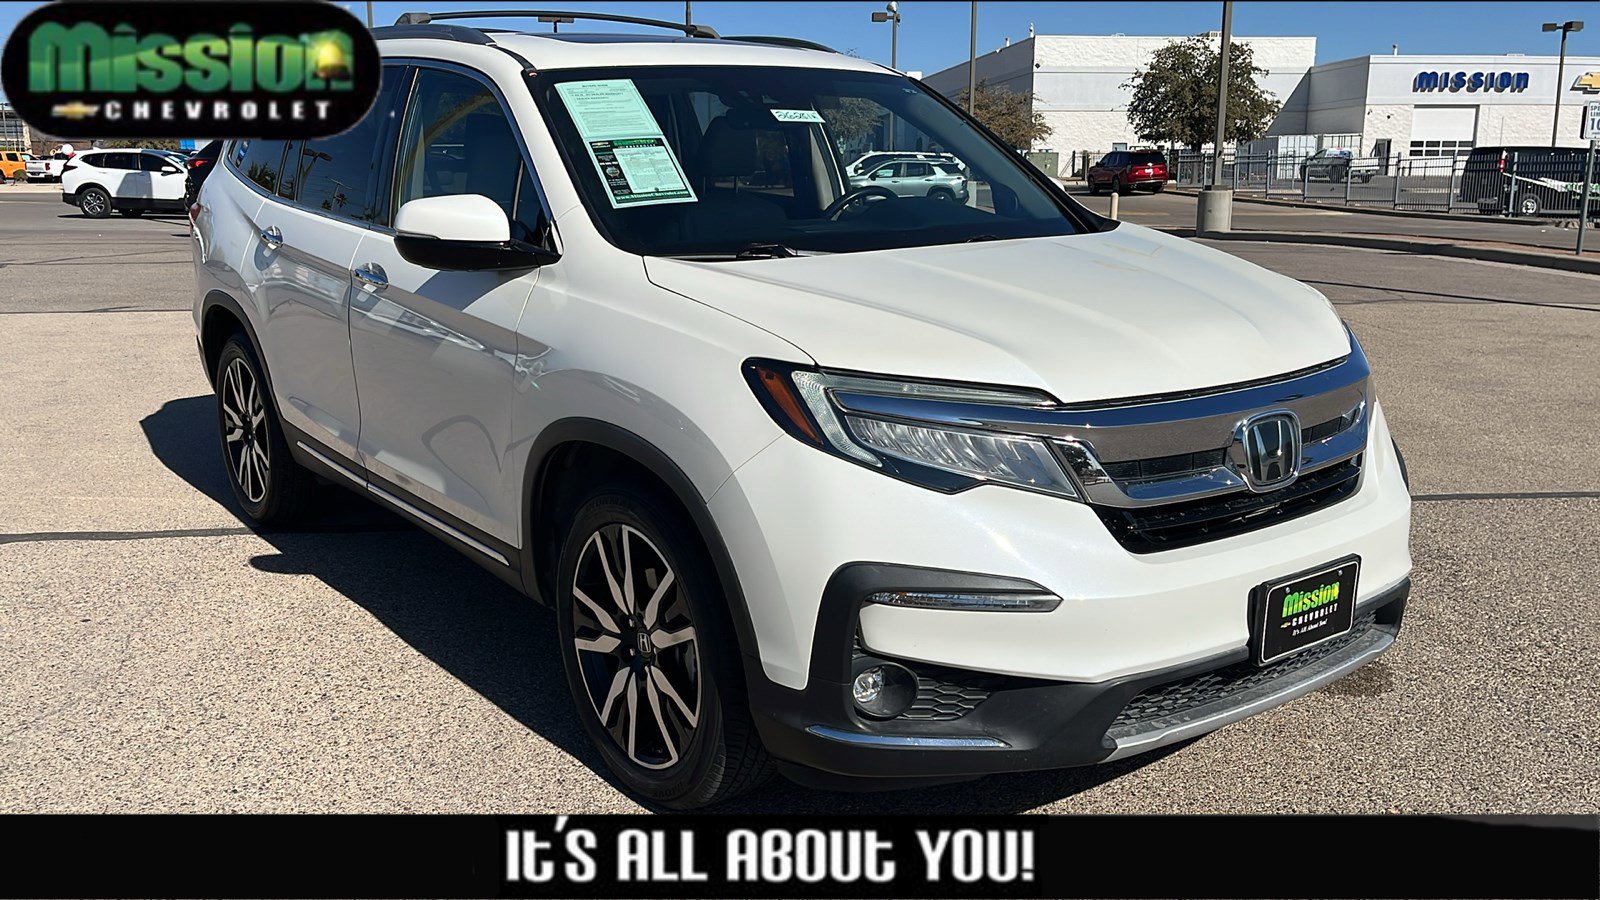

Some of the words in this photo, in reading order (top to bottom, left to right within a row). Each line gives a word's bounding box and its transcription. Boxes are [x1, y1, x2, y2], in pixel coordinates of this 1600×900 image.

[1413, 71, 1530, 93] MISSION
[1281, 581, 1340, 618] Mission
[1291, 603, 1338, 627] CHEVROLET
